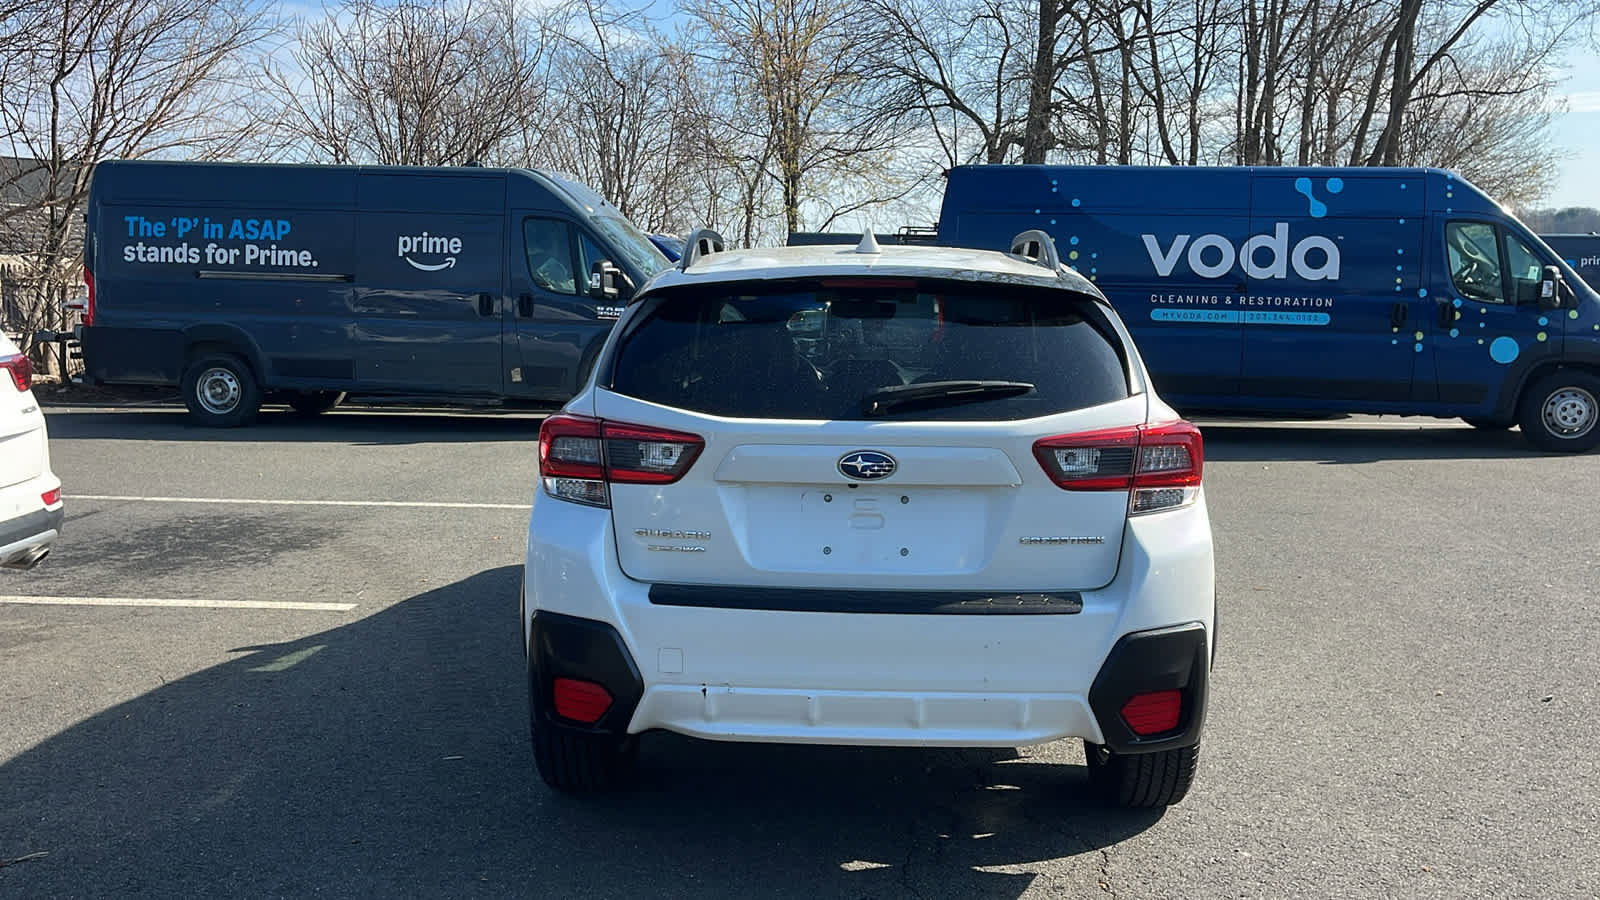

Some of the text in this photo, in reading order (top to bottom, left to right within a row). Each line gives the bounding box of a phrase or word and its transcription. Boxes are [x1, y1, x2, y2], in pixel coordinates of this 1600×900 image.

[124, 216, 166, 238] The
[203, 217, 224, 240] in
[228, 218, 291, 241] ASAP
[123, 242, 319, 267] stands for Prime.
[398, 231, 463, 257] prime
[1141, 222, 1341, 281] voda
[1150, 294, 1333, 307] CLEANING & RESTORATION
[1162, 311, 1227, 321] MYVODA.COM
